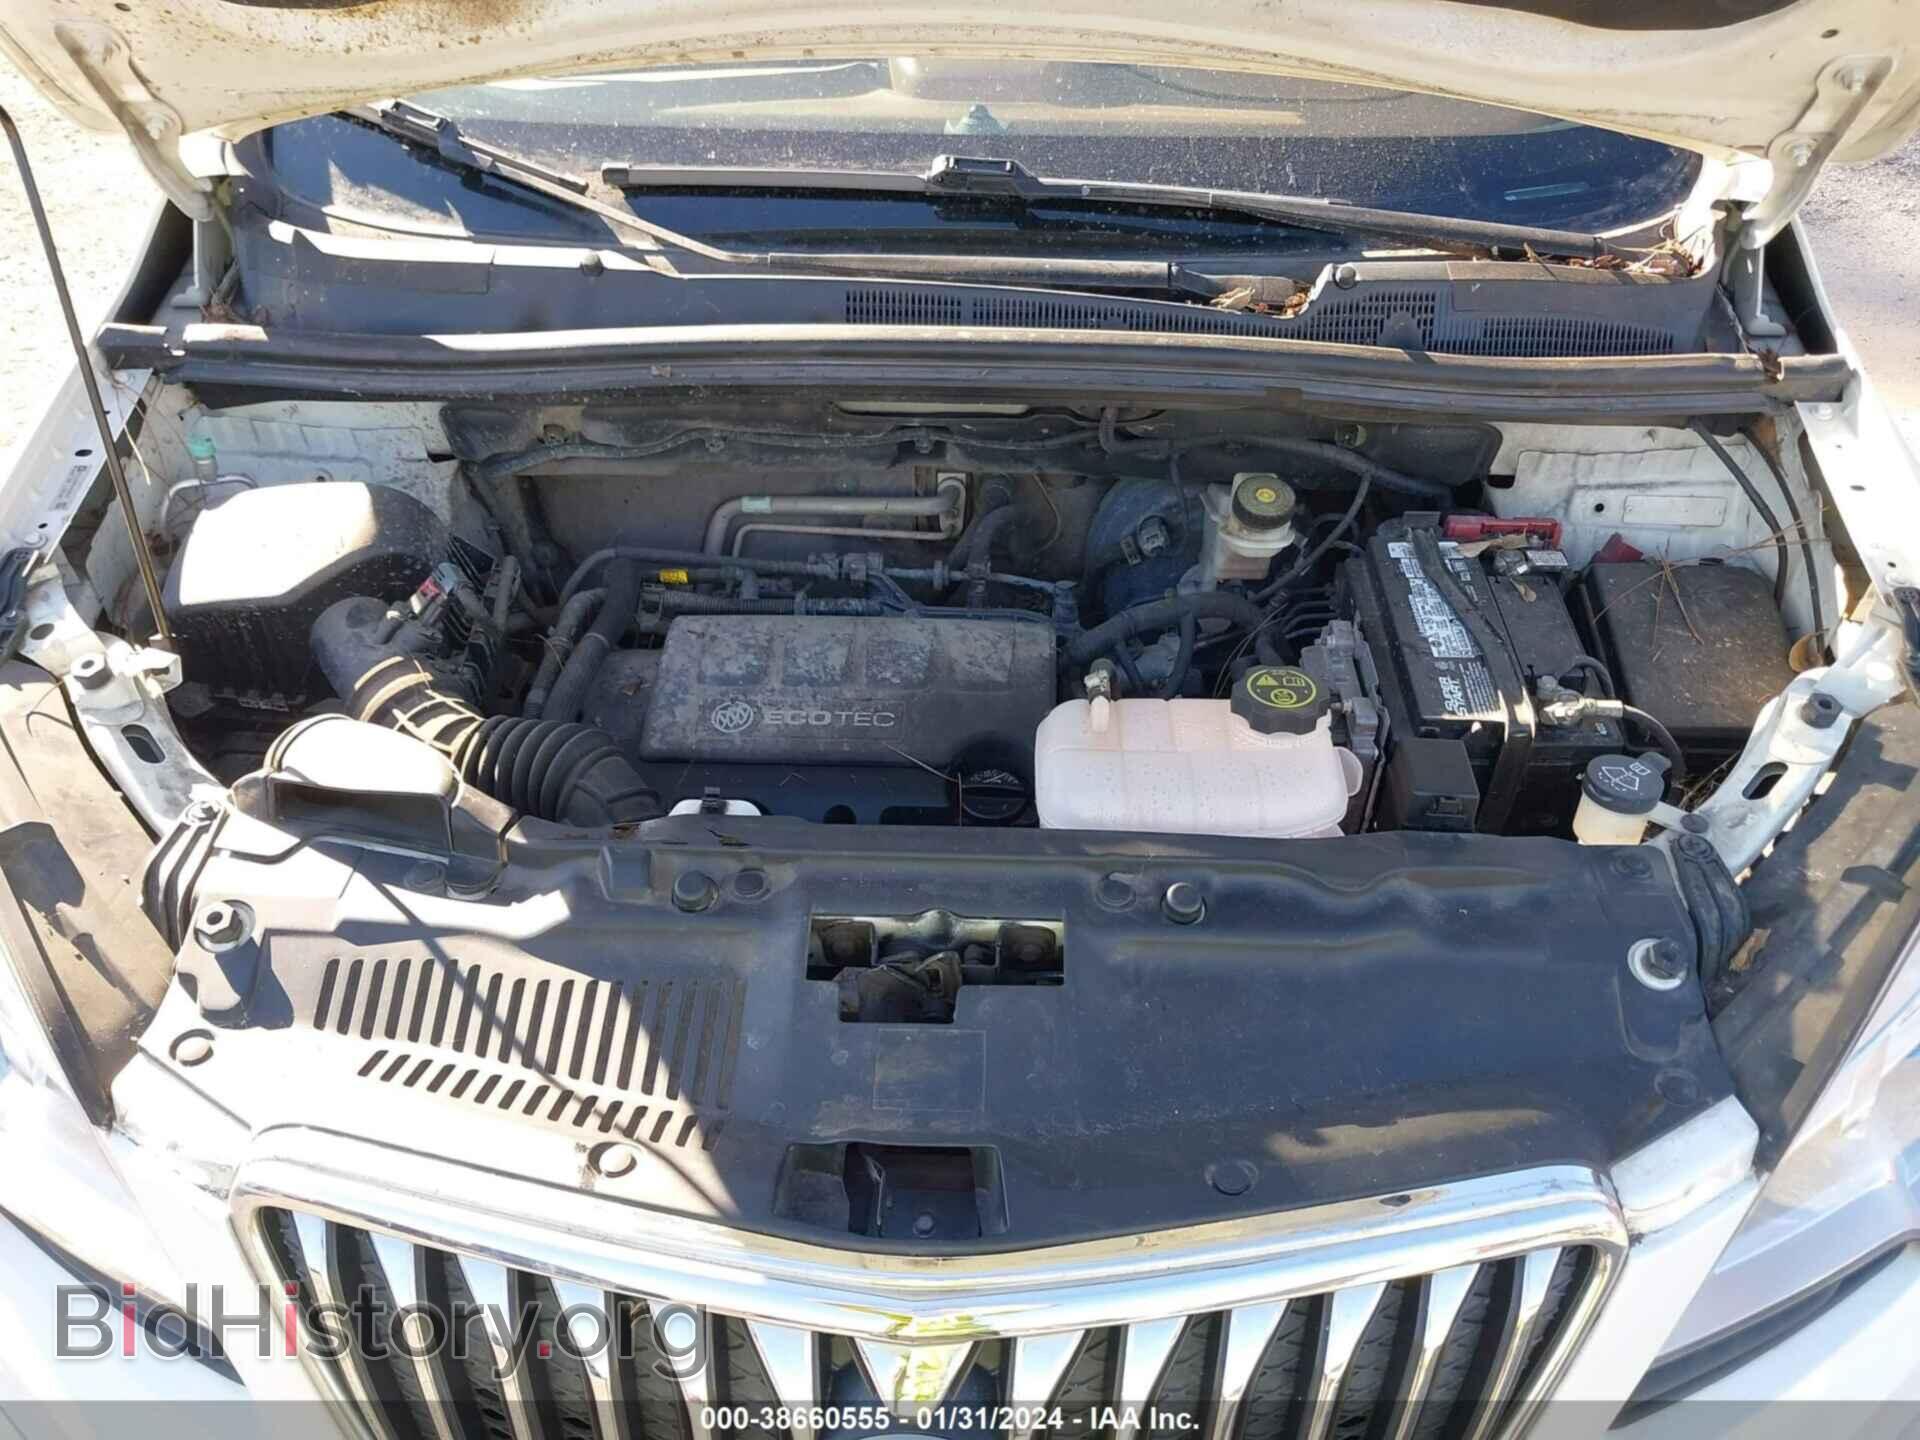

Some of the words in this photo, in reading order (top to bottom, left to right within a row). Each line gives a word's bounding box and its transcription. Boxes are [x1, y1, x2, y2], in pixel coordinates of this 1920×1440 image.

[1438, 676, 1455, 711] SUPER
[1450, 679, 1467, 716] START
[764, 710, 896, 727] ECOTEC
